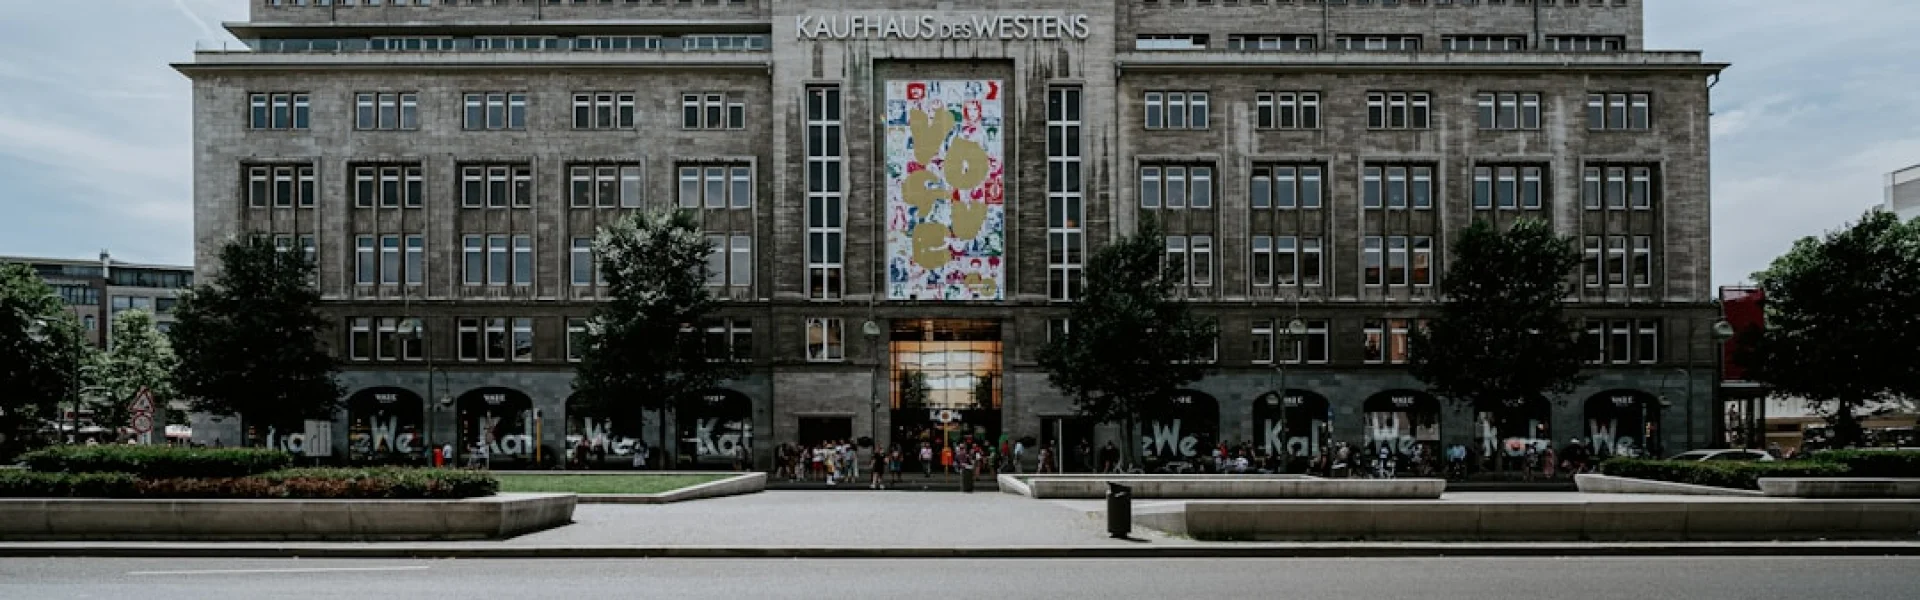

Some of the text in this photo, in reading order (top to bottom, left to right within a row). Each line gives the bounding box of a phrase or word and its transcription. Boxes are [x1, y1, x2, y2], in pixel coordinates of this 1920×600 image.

[796, 15, 1090, 40] KAUFHAUS DES WESTENS
